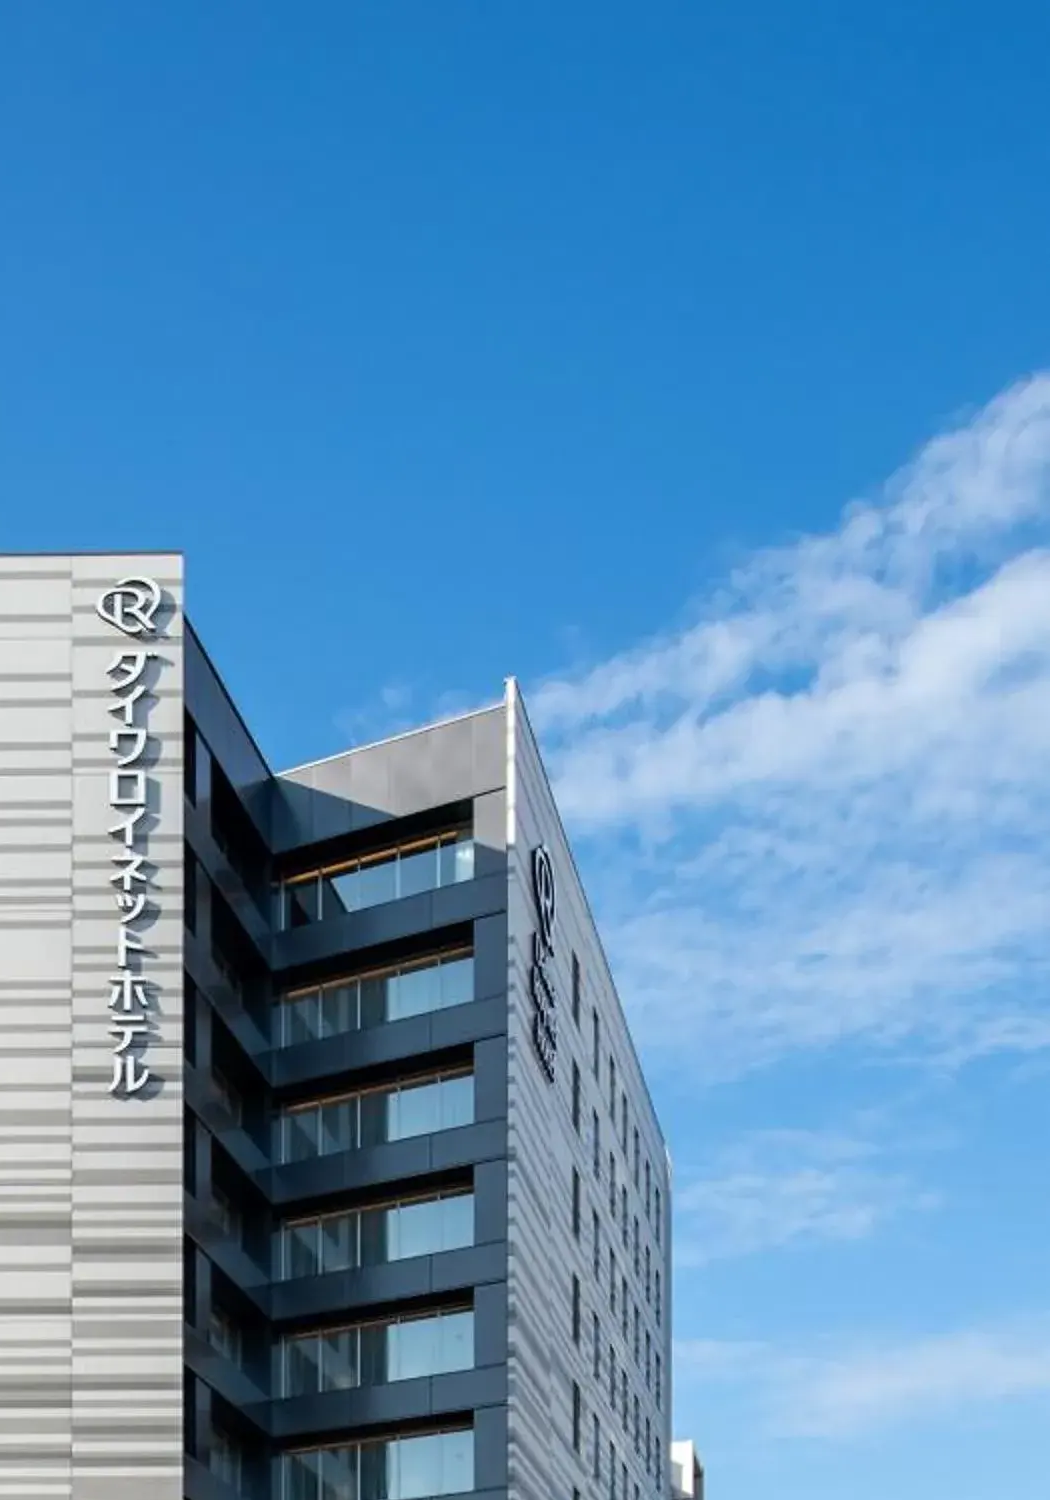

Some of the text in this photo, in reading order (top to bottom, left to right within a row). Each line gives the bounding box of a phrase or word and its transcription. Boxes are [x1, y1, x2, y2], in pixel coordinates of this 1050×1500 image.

[106, 650, 158, 1095] ダイワロイネットホテル
